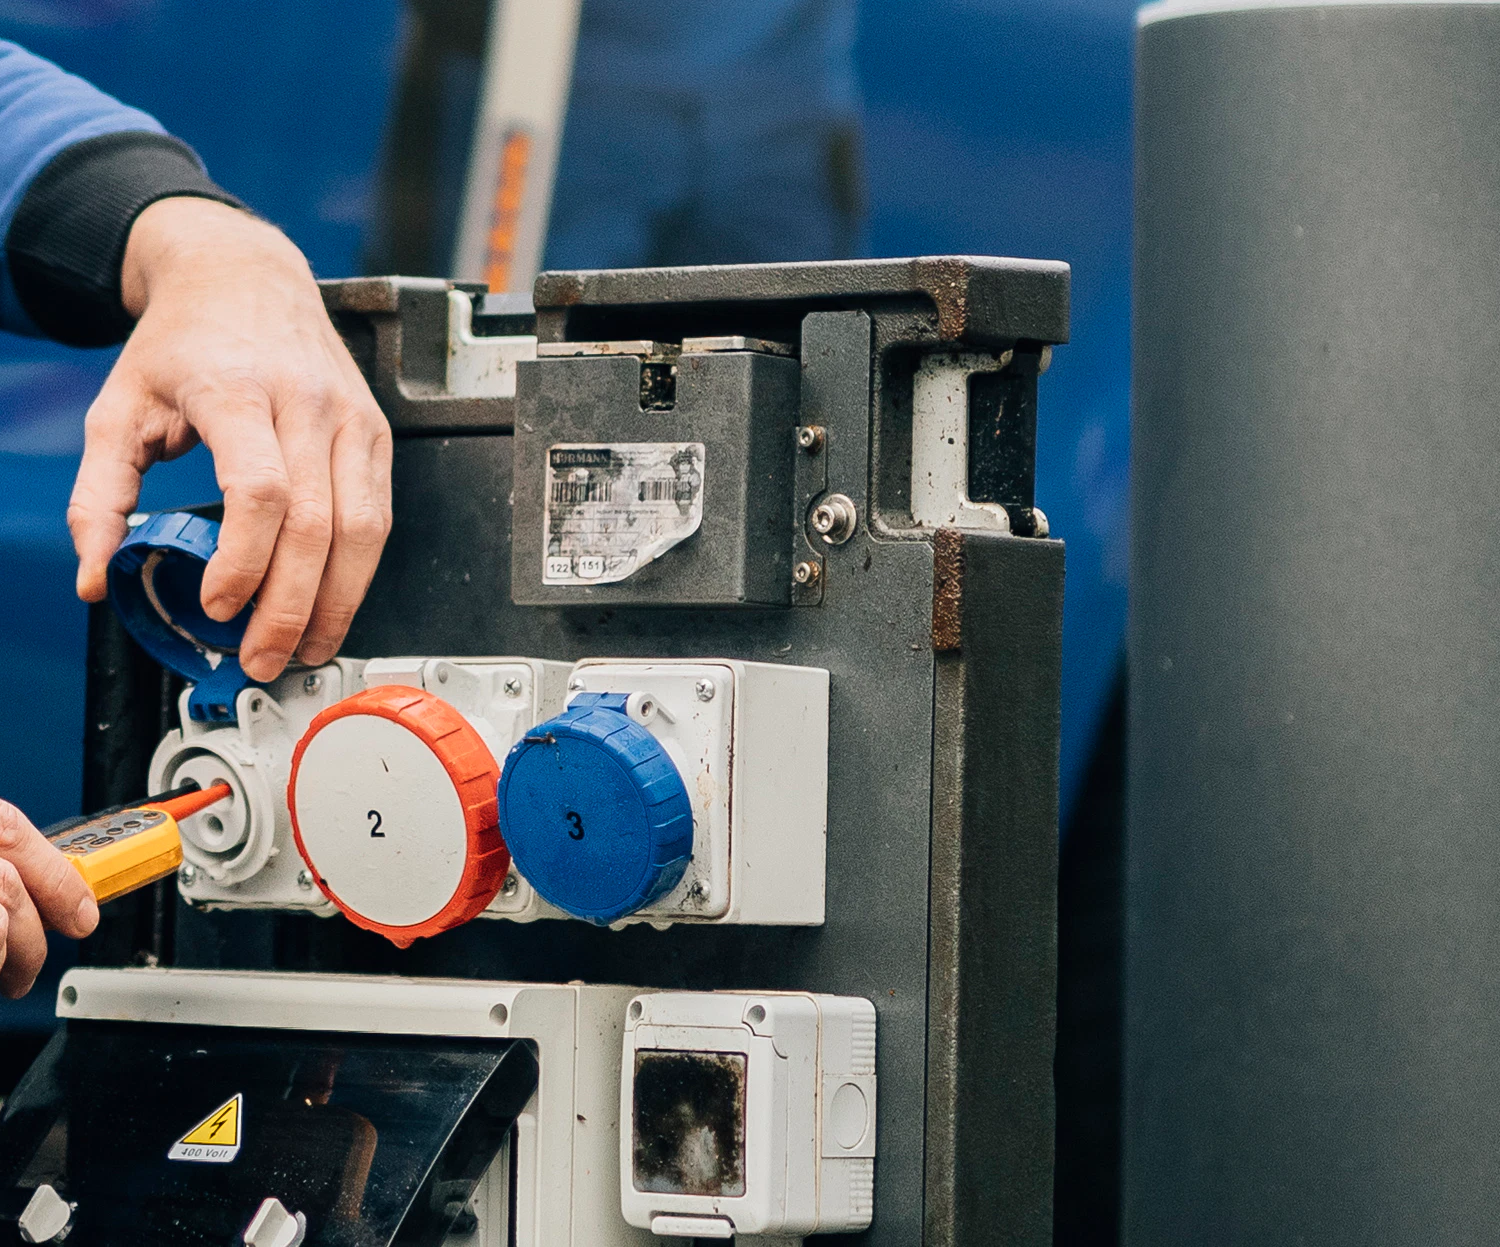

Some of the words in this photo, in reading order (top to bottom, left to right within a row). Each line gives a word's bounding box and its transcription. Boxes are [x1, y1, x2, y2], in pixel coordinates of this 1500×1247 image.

[550, 563, 568, 573] 122
[582, 561, 599, 570] 151
[367, 810, 385, 838] 2
[566, 811, 585, 840] 3
[205, 1148, 228, 1158] Volt
